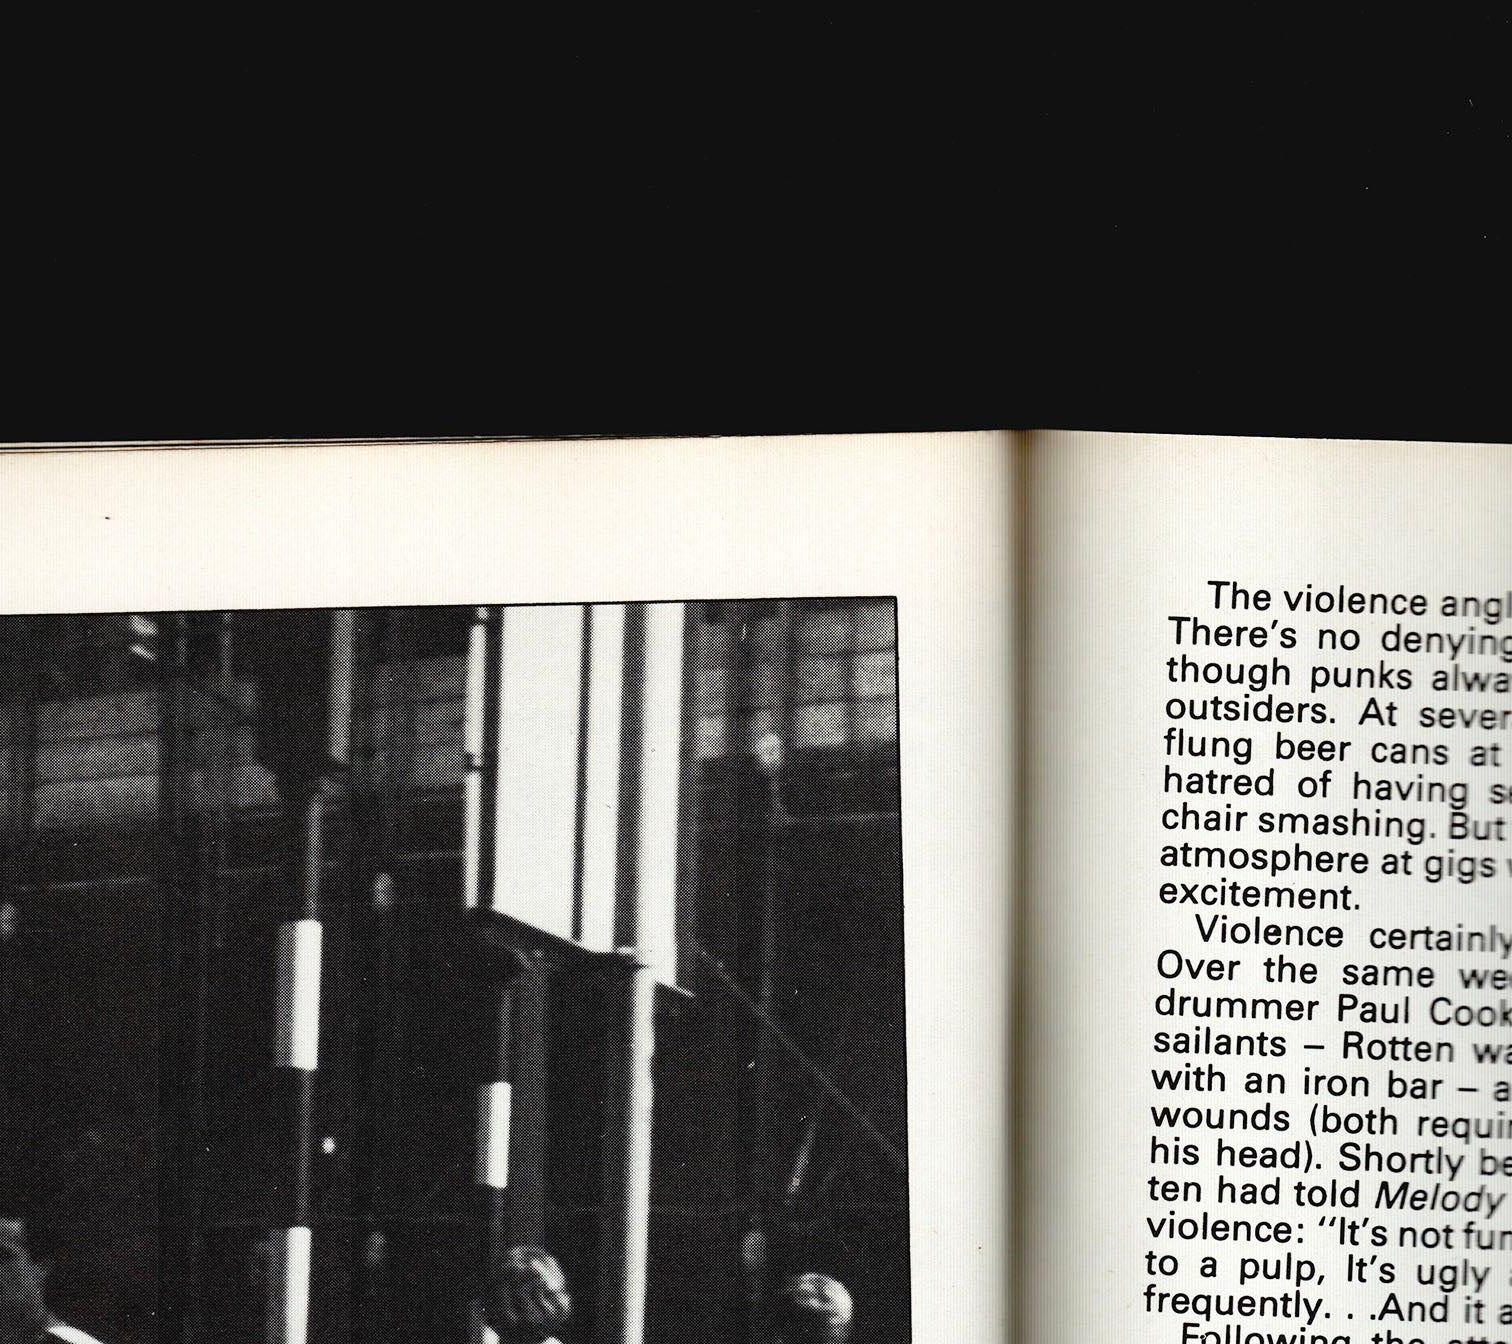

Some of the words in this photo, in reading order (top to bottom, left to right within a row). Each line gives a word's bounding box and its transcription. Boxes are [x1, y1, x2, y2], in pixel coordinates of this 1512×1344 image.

[1283, 583, 1428, 617] violence
[1165, 653, 1291, 693] though
[1310, 659, 1413, 694] punks
[1165, 693, 1336, 725] outsiders.
[1163, 726, 1253, 766] flung
[1275, 731, 1352, 762] beer
[1370, 742, 1449, 766] cans
[1164, 764, 1275, 797] hatred
[1353, 771, 1468, 811] having
[1161, 801, 1249, 832] chair
[1258, 807, 1436, 846] smashing.
[1160, 842, 1369, 878] atmosphere
[1159, 877, 1360, 911] excitement.
[1194, 913, 1344, 948] Violence
[1157, 949, 1241, 981] Over
[1342, 963, 1435, 989] same
[1154, 987, 1320, 1022] drummer
[1337, 993, 1410, 1024] Paul
[1153, 1025, 1287, 1058] sailants
[1342, 1030, 1454, 1063] Rotten
[1150, 1062, 1226, 1092] with
[1303, 1066, 1370, 1098] iron
[1150, 1102, 1290, 1132] wounds
[1309, 1102, 1398, 1137] (both
[1216, 1137, 1322, 1174] head).
[1338, 1141, 1465, 1182] Shortly
[1293, 1178, 1360, 1209] told
[1146, 1210, 1304, 1244] violence:
[1239, 1251, 1325, 1288] pulp,
[1142, 1283, 1331, 1326] frequently.
